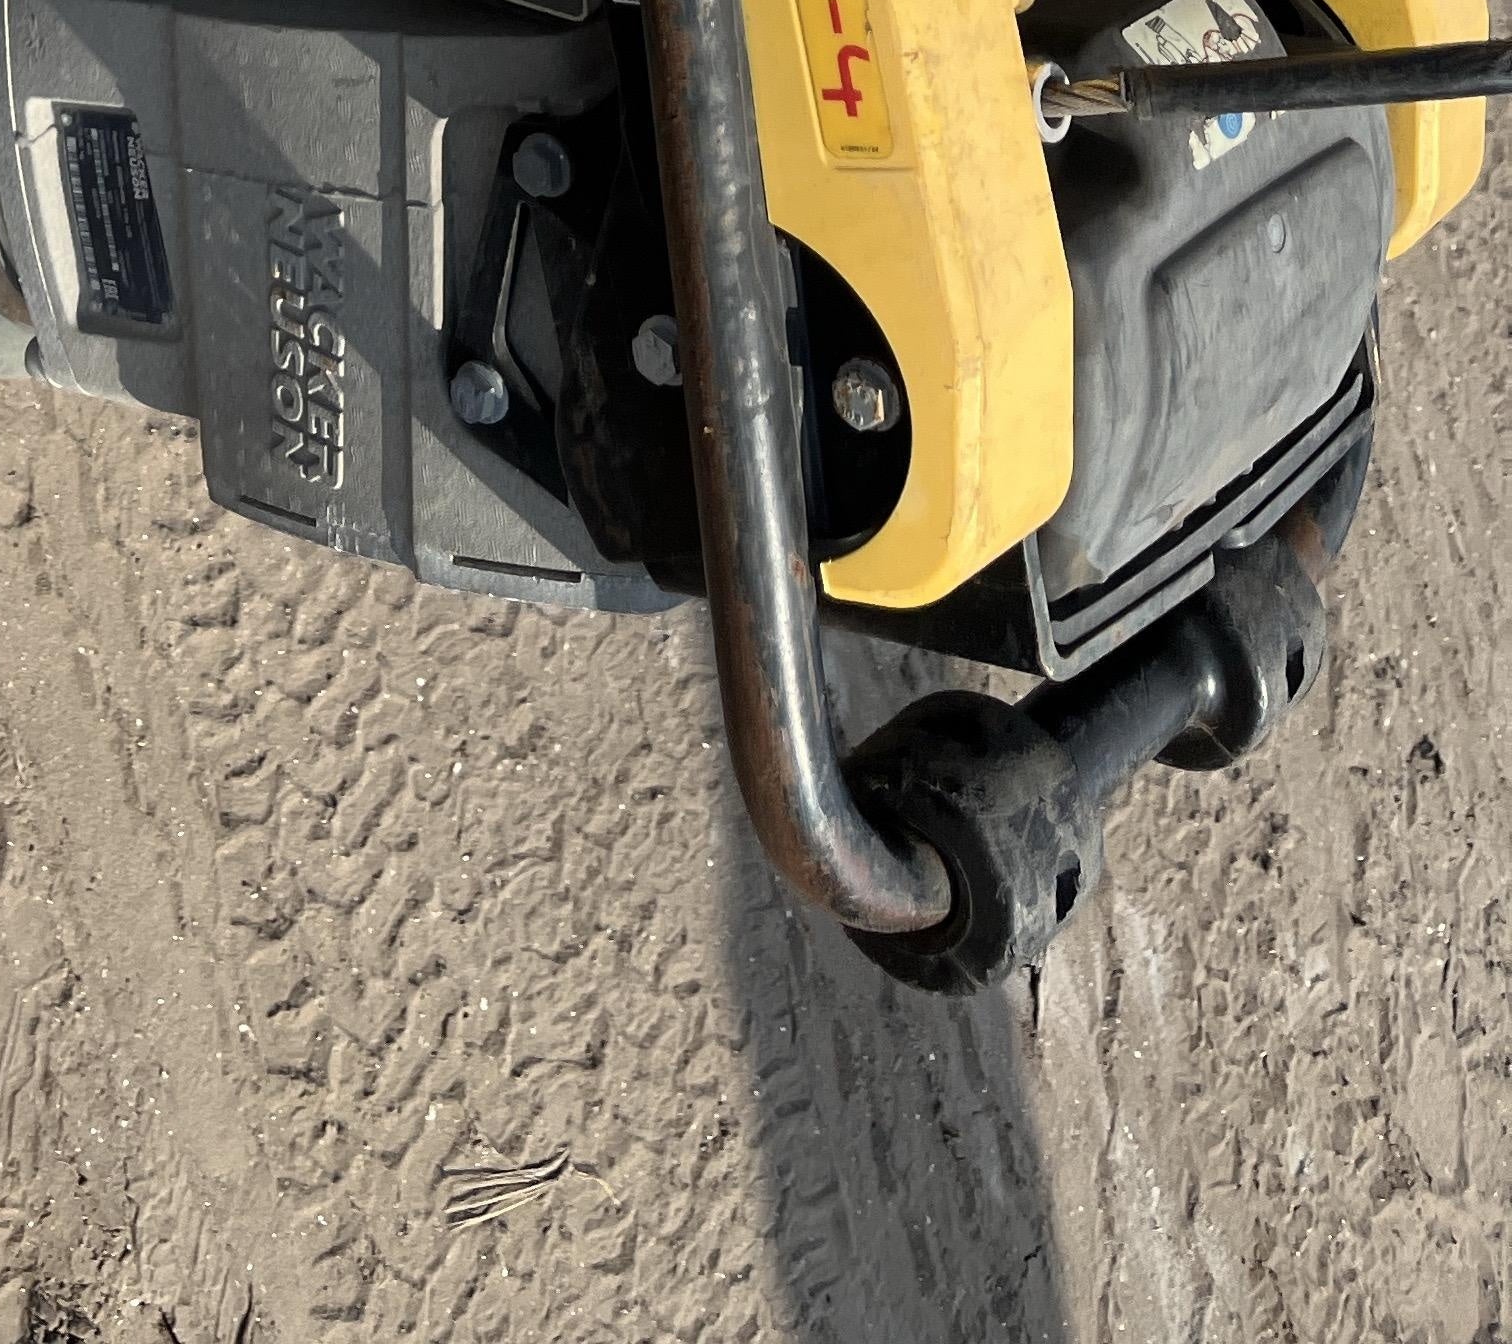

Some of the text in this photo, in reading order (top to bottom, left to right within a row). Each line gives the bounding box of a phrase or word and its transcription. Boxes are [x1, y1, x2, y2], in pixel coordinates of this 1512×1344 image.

[127, 136, 143, 200] NEUSON
[269, 190, 306, 466] NEUSON
[299, 203, 346, 490] WACKER
